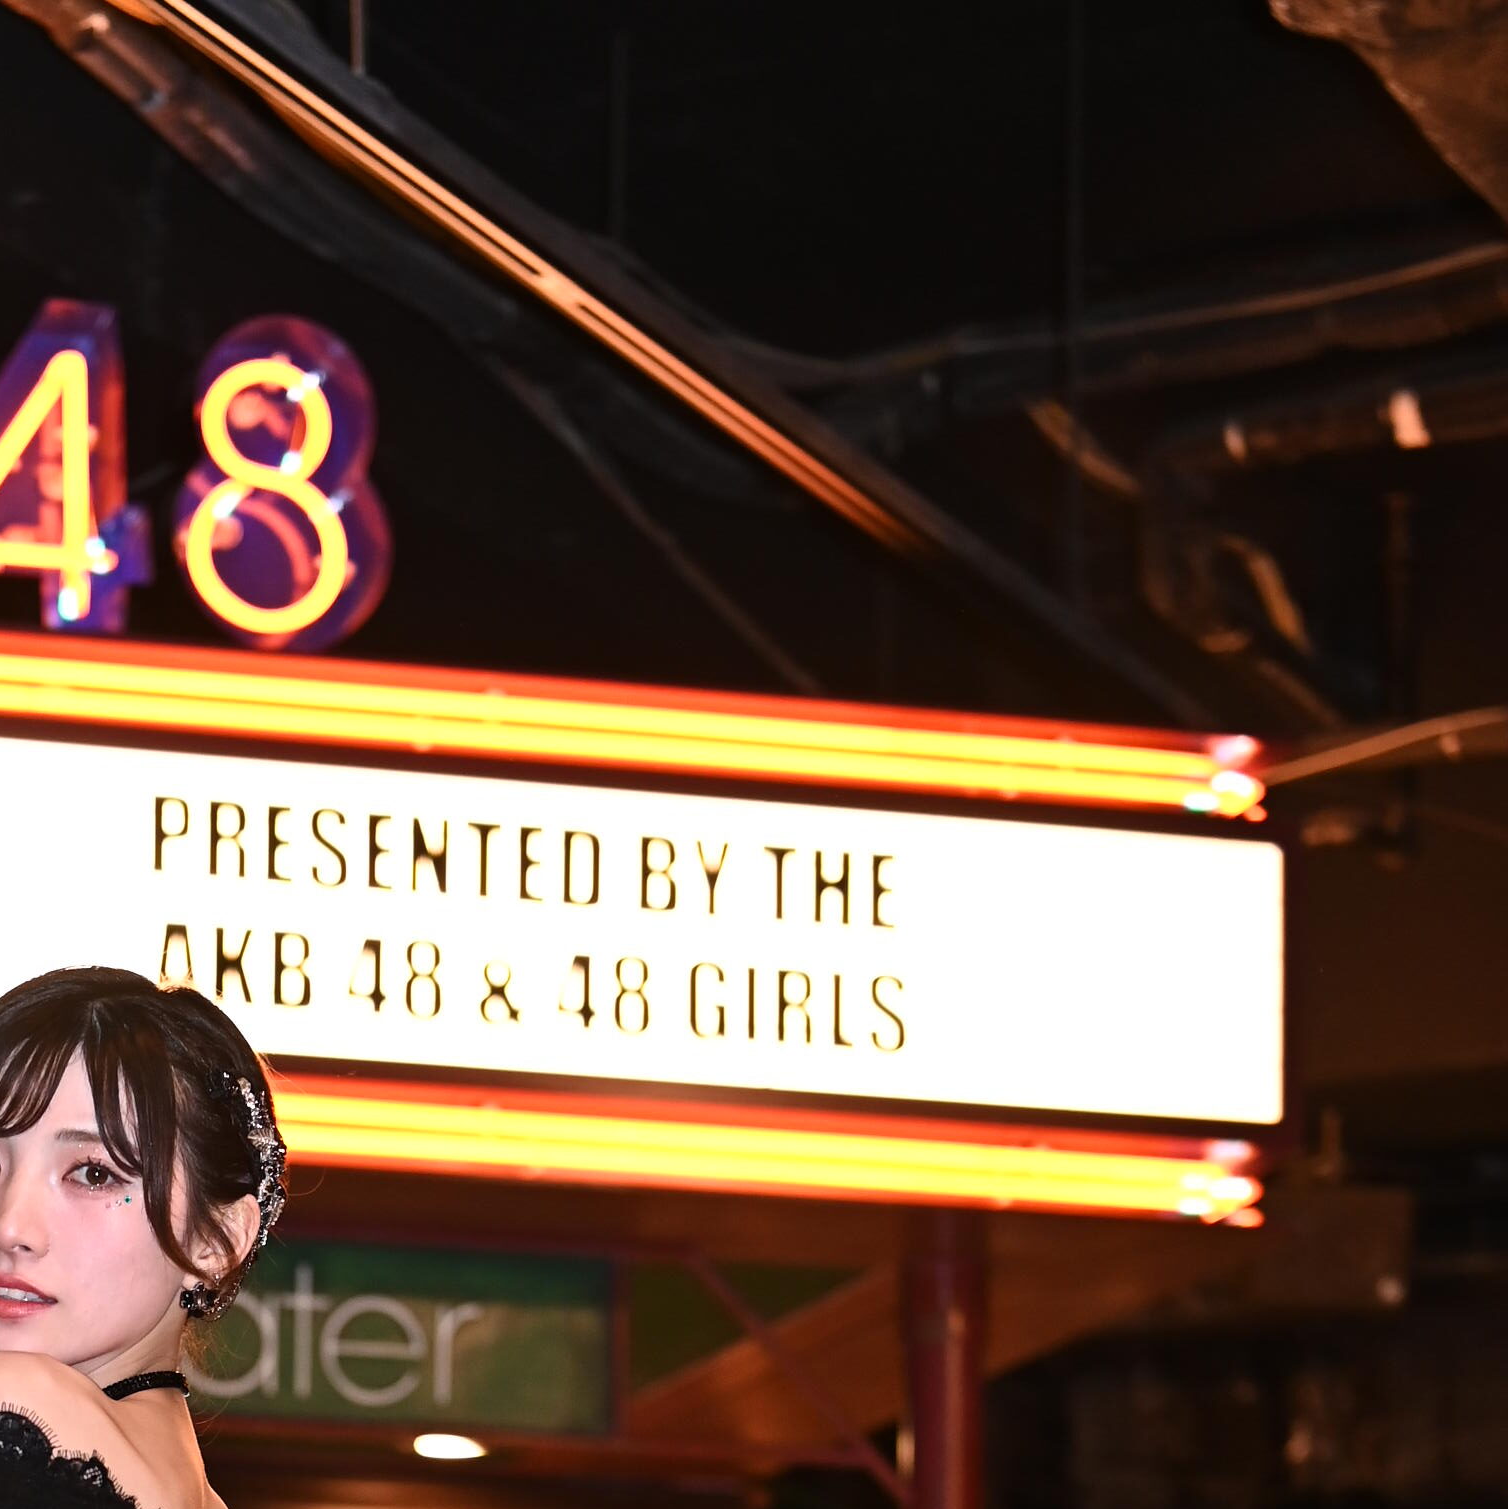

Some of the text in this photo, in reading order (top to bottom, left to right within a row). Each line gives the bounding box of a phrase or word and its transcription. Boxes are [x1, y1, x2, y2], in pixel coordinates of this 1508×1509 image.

[153, 797, 894, 929] PRESENTED BY THE
[159, 923, 906, 1052] AKB 48 & 48 GIRLS
[186, 1262, 483, 1407] ater
